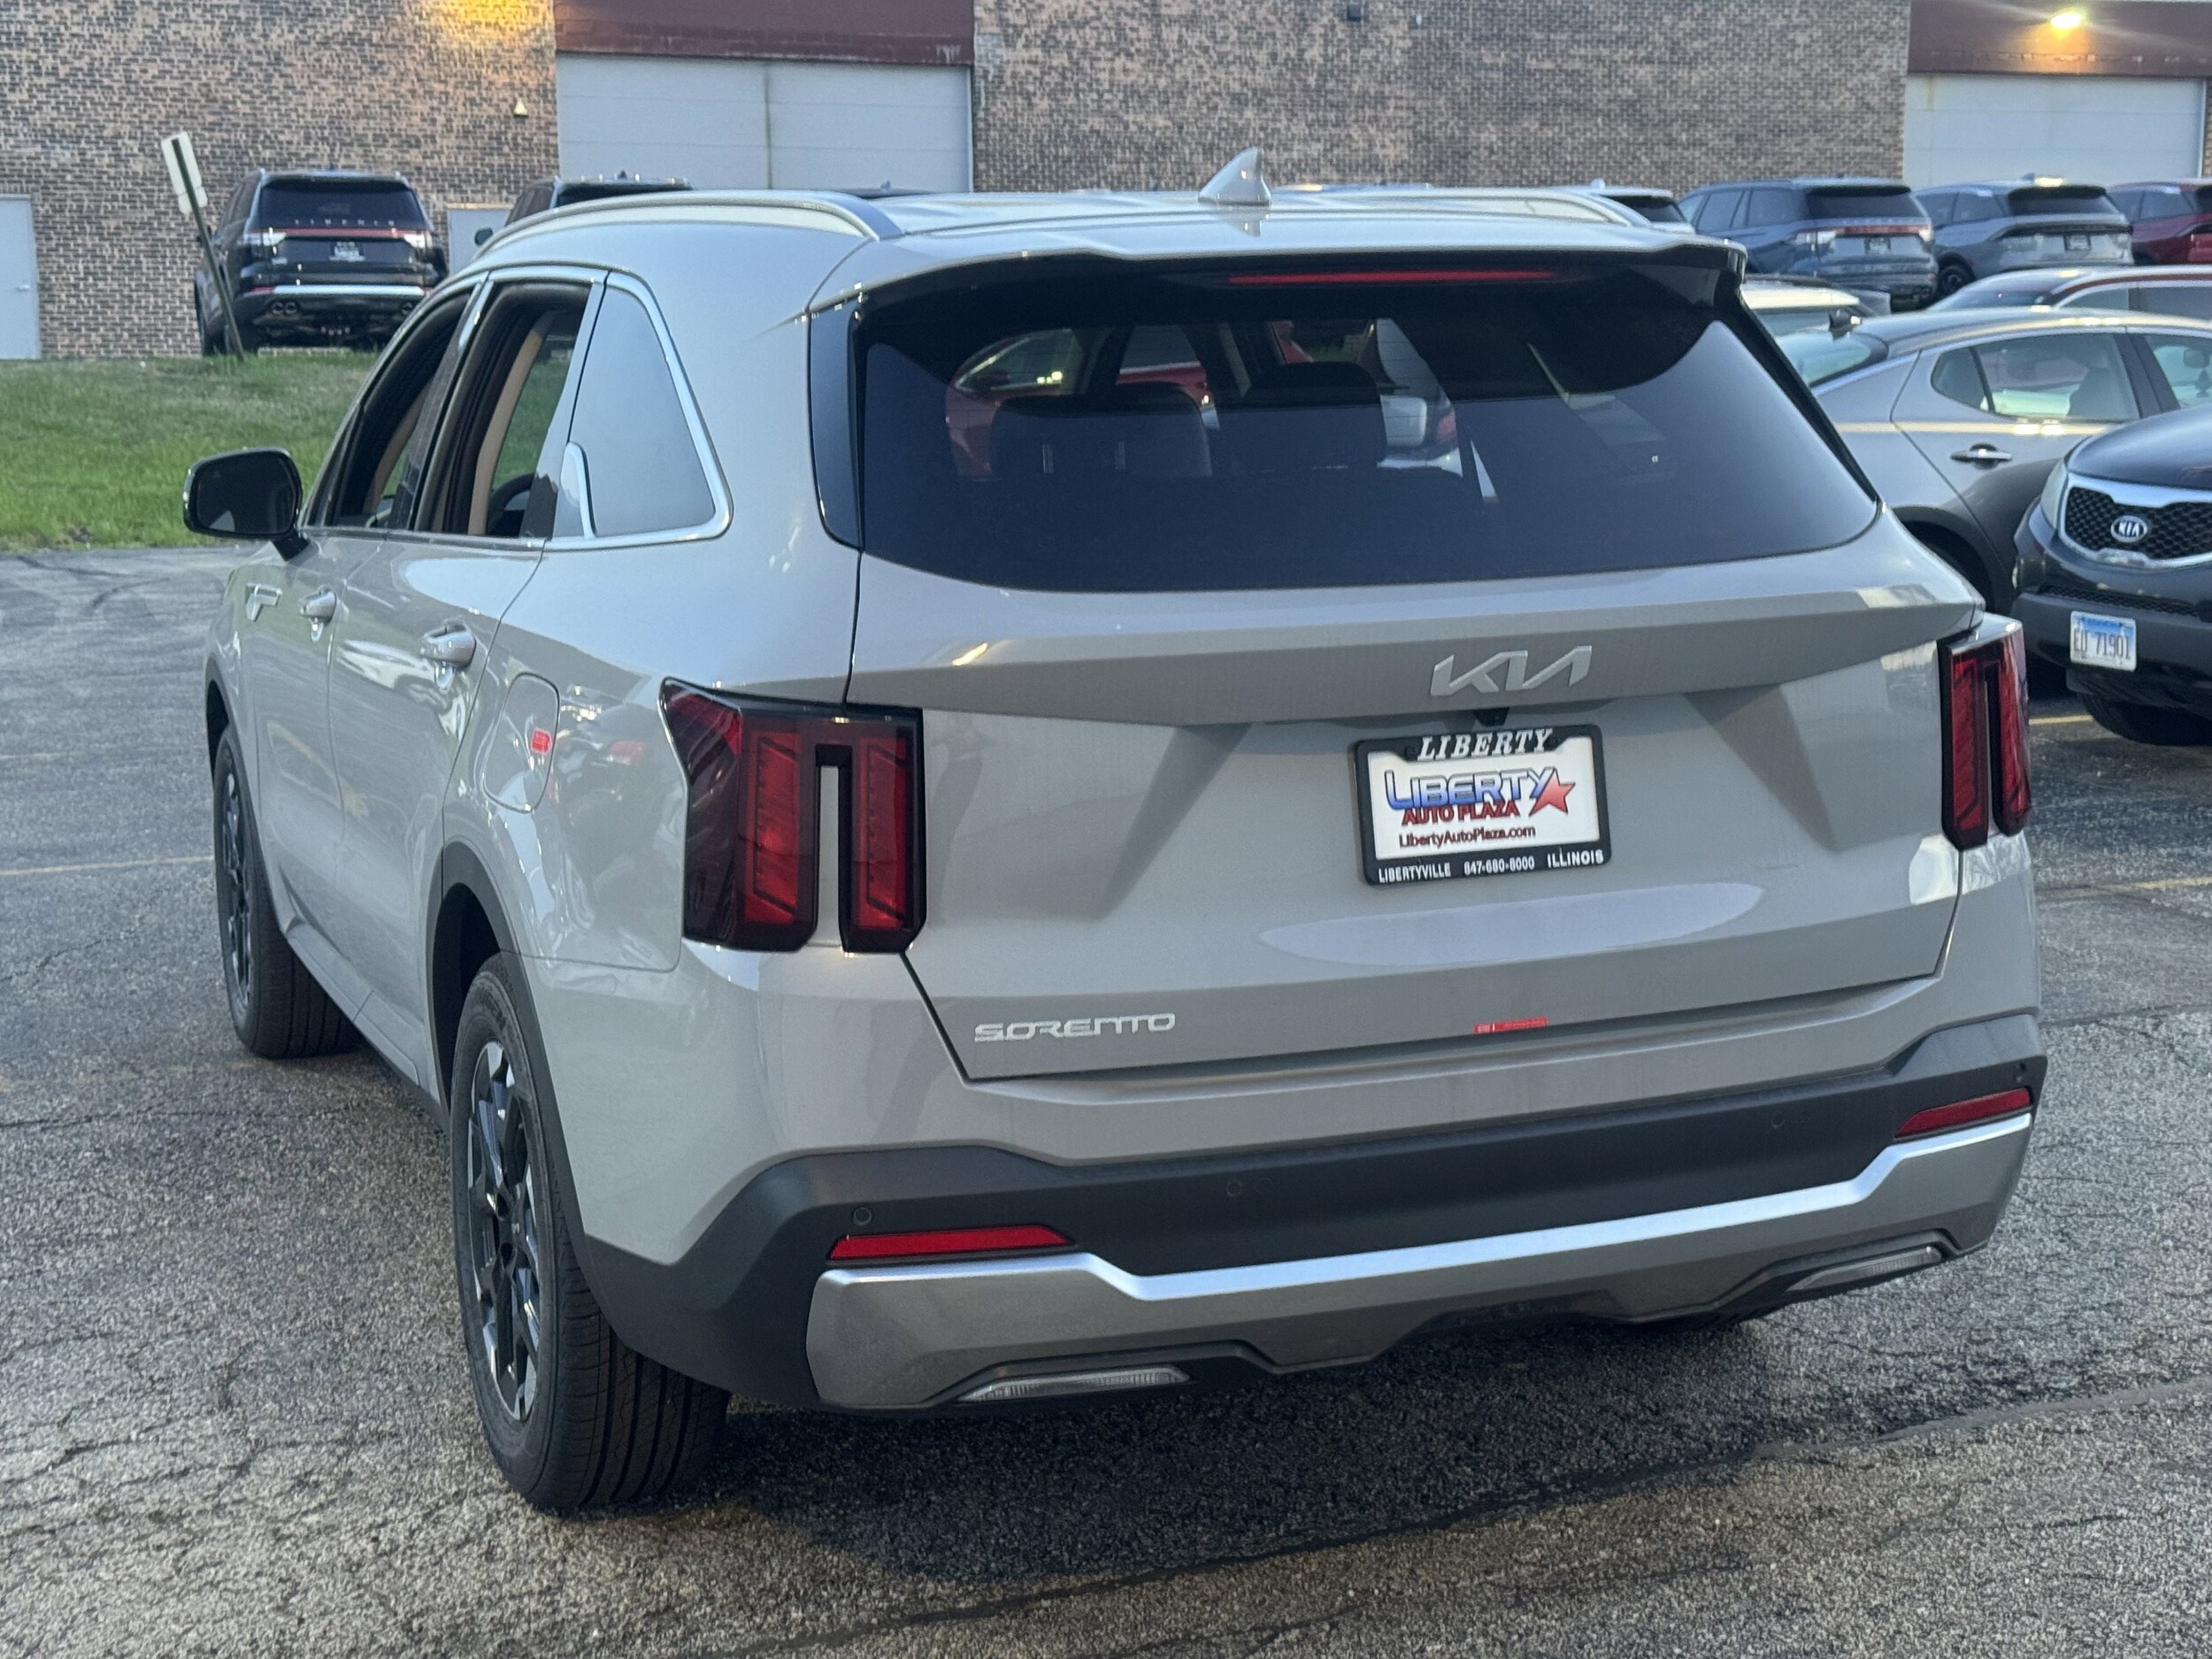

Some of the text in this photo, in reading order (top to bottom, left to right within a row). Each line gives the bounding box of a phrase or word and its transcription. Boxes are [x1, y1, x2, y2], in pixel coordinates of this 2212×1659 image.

[2118, 522, 2140, 537] KIA
[1417, 728, 1553, 762] LIBERTY
[1384, 766, 1556, 810] LIBERTY
[1402, 800, 1521, 826] AUTO PLAZA
[1399, 826, 1536, 849] LibertyAutoPlaza.com
[1378, 862, 1452, 884] LIBERTYVILLE
[1548, 849, 1604, 869] ILLINOIS
[974, 1013, 1176, 1042] SORENTO
